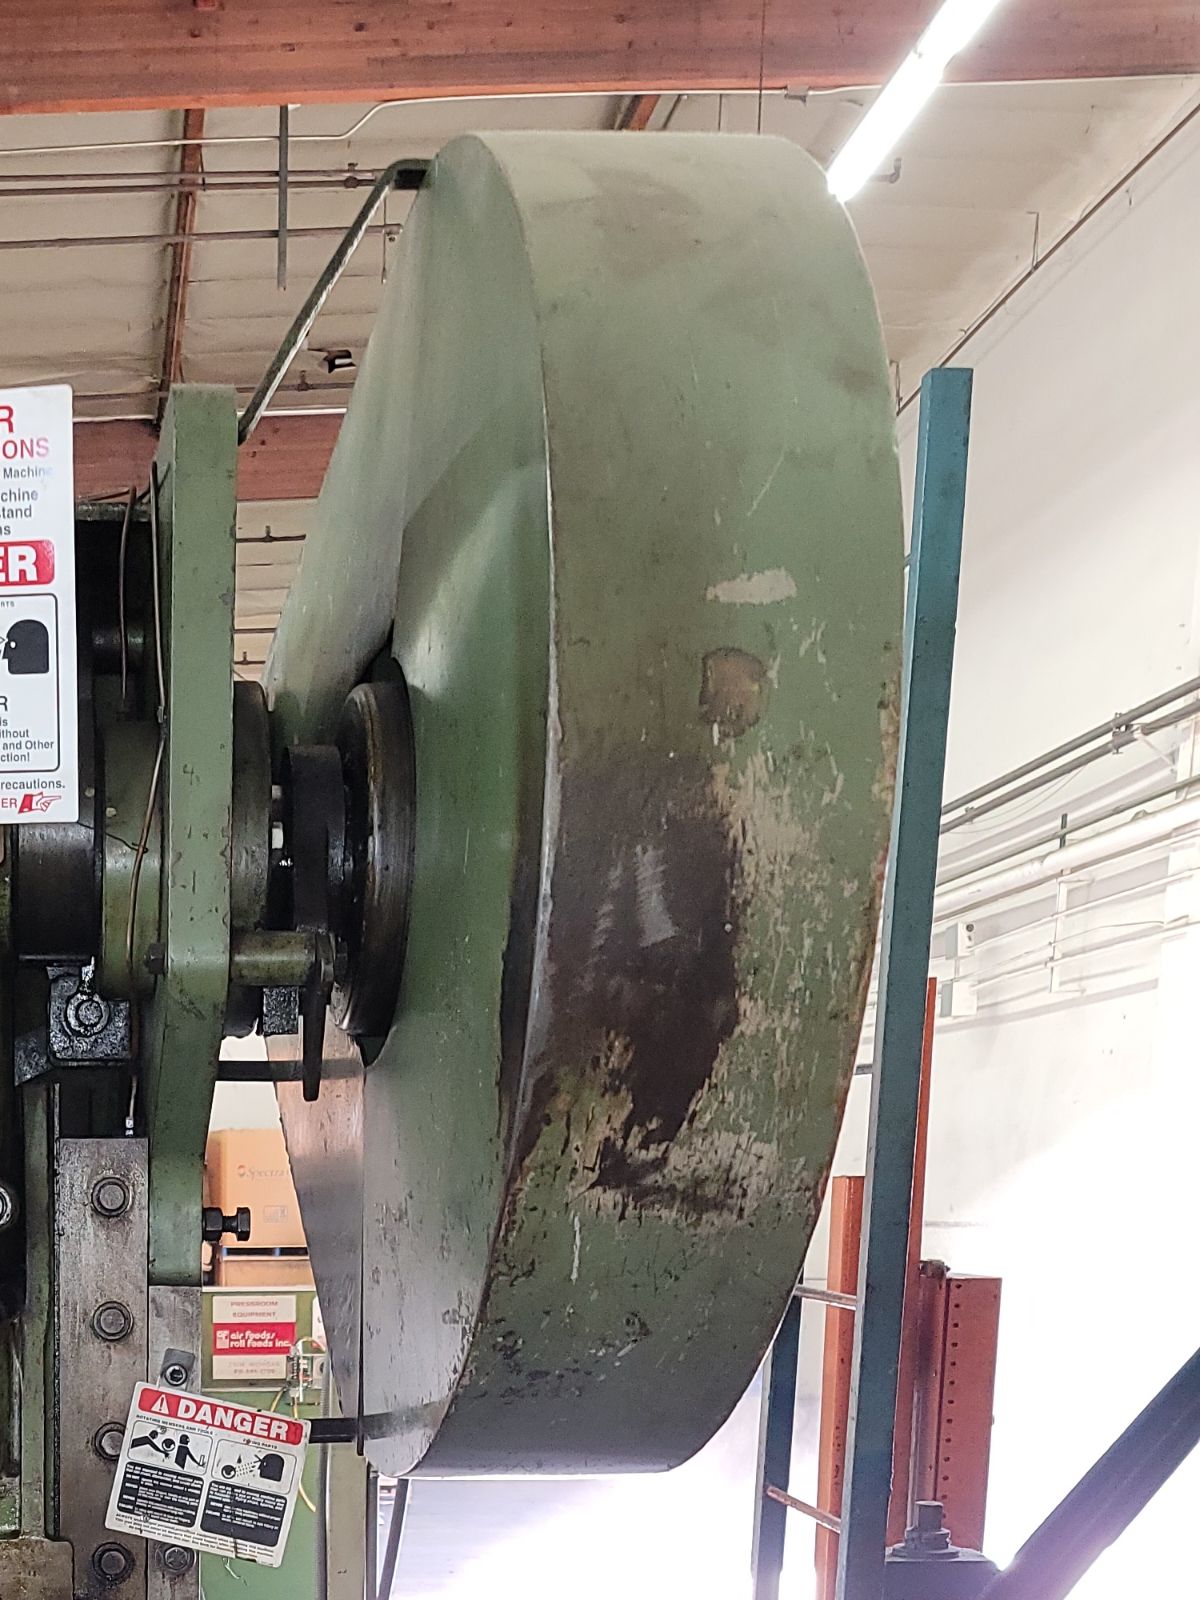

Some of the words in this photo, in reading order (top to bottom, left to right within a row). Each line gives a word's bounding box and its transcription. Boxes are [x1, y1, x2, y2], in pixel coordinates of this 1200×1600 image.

[2, 740, 22, 751] and
[24, 739, 55, 750] Other
[176, 1398, 289, 1441] DANGER
